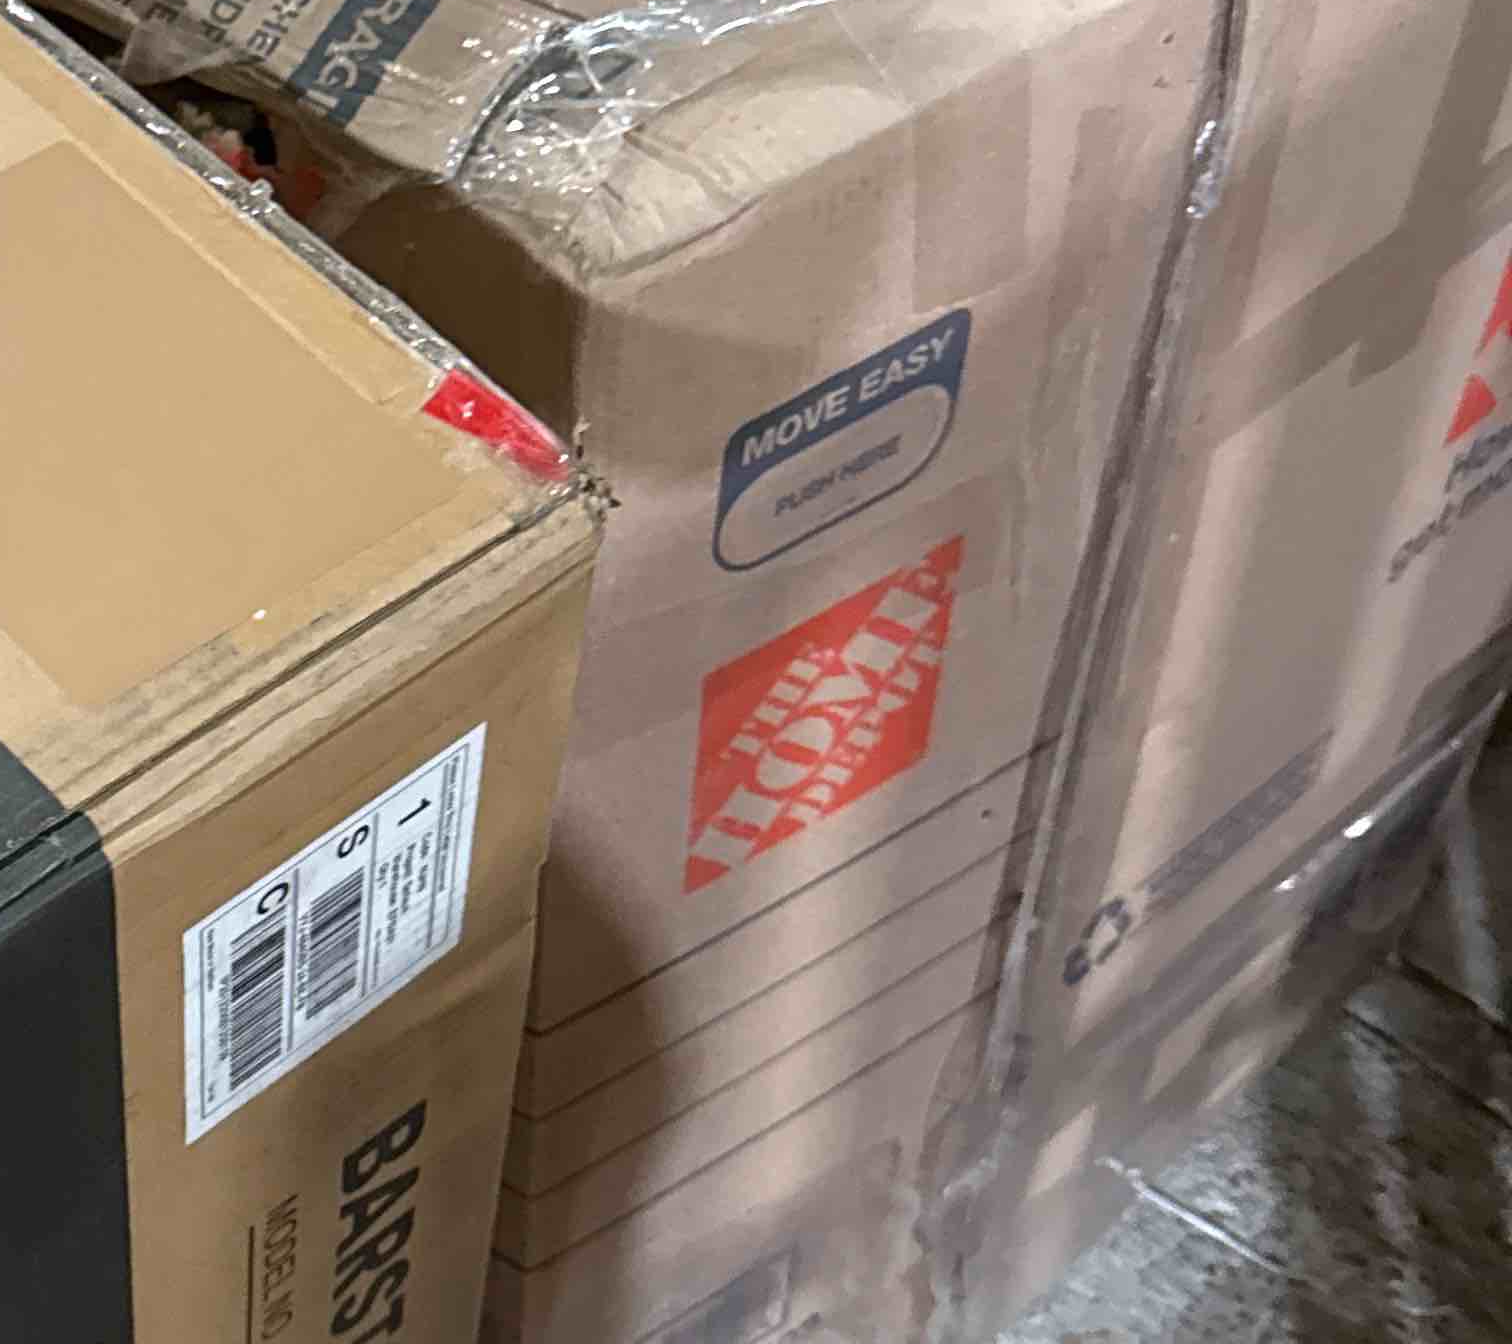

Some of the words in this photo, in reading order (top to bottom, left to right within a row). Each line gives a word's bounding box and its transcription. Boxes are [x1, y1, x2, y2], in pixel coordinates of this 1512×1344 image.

[741, 386, 850, 467] MOVE
[859, 328, 955, 403] EASY
[691, 564, 943, 860] HOME
[397, 792, 432, 828] 1
[336, 820, 370, 864] S
[256, 875, 290, 921] C
